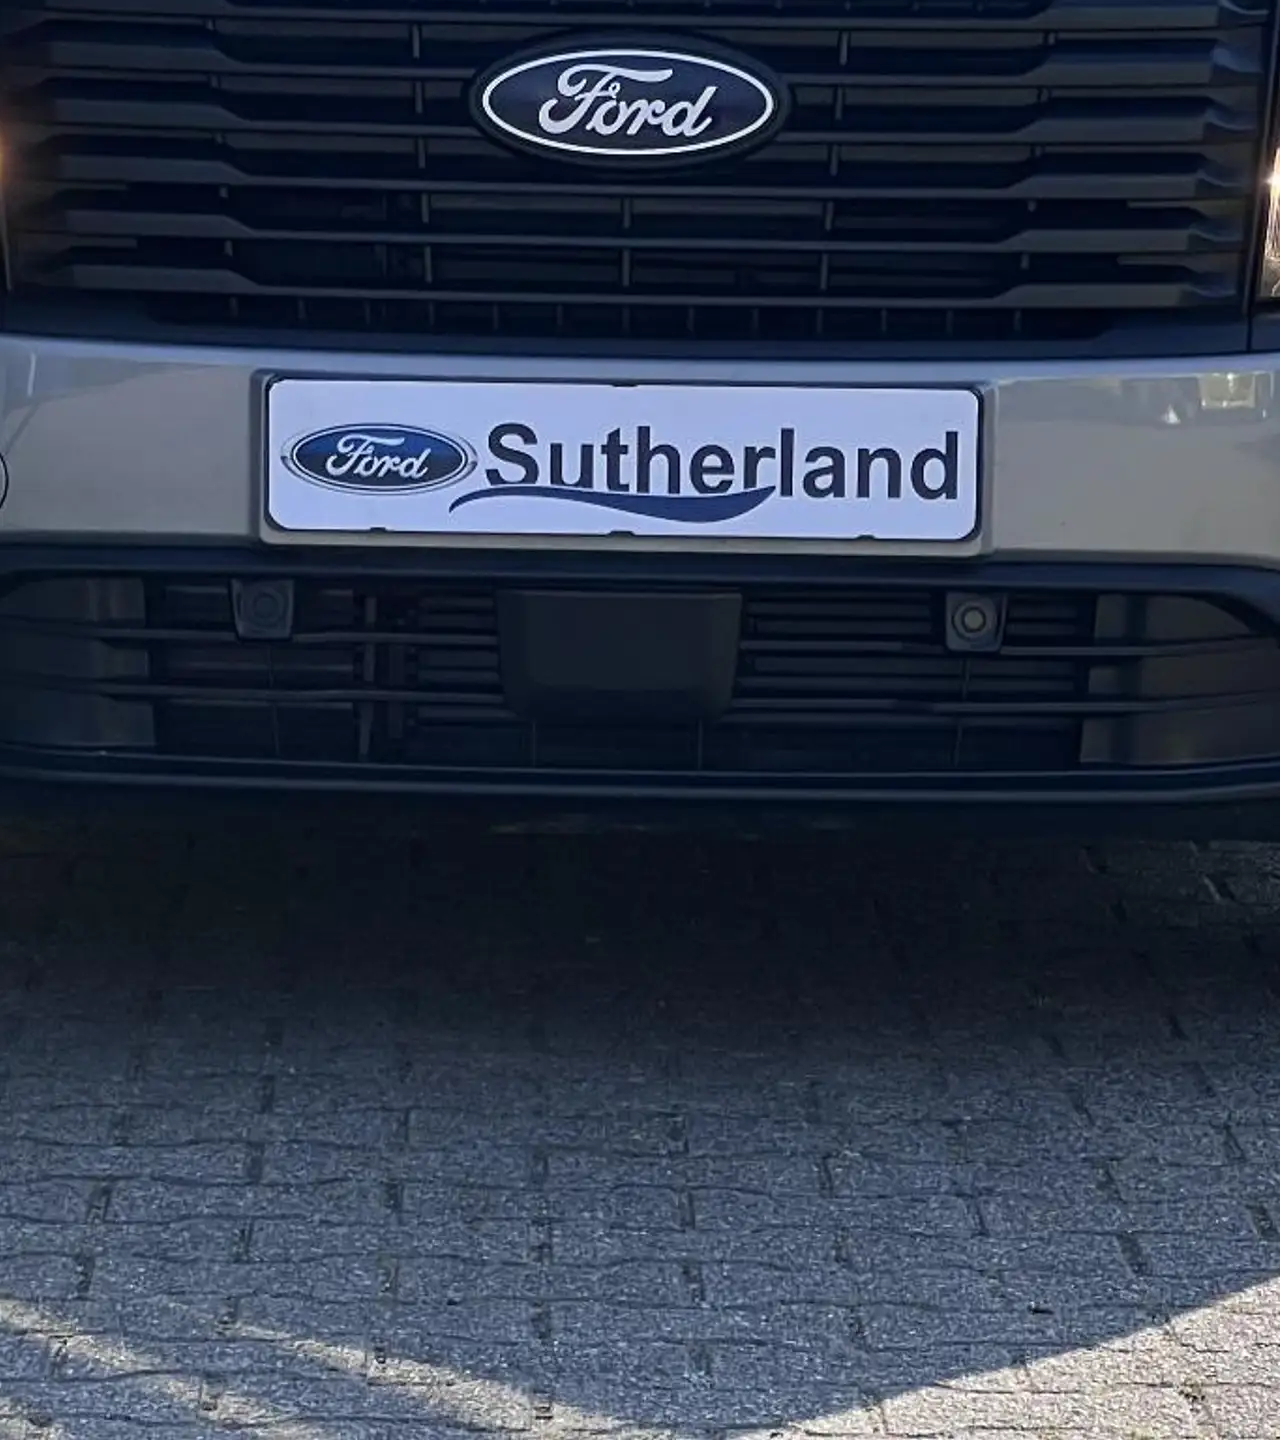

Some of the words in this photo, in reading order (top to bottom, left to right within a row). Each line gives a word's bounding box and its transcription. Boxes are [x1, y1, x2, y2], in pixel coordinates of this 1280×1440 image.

[538, 63, 718, 137] Ford
[325, 433, 432, 479] Ford
[485, 422, 959, 500] Sutherland
